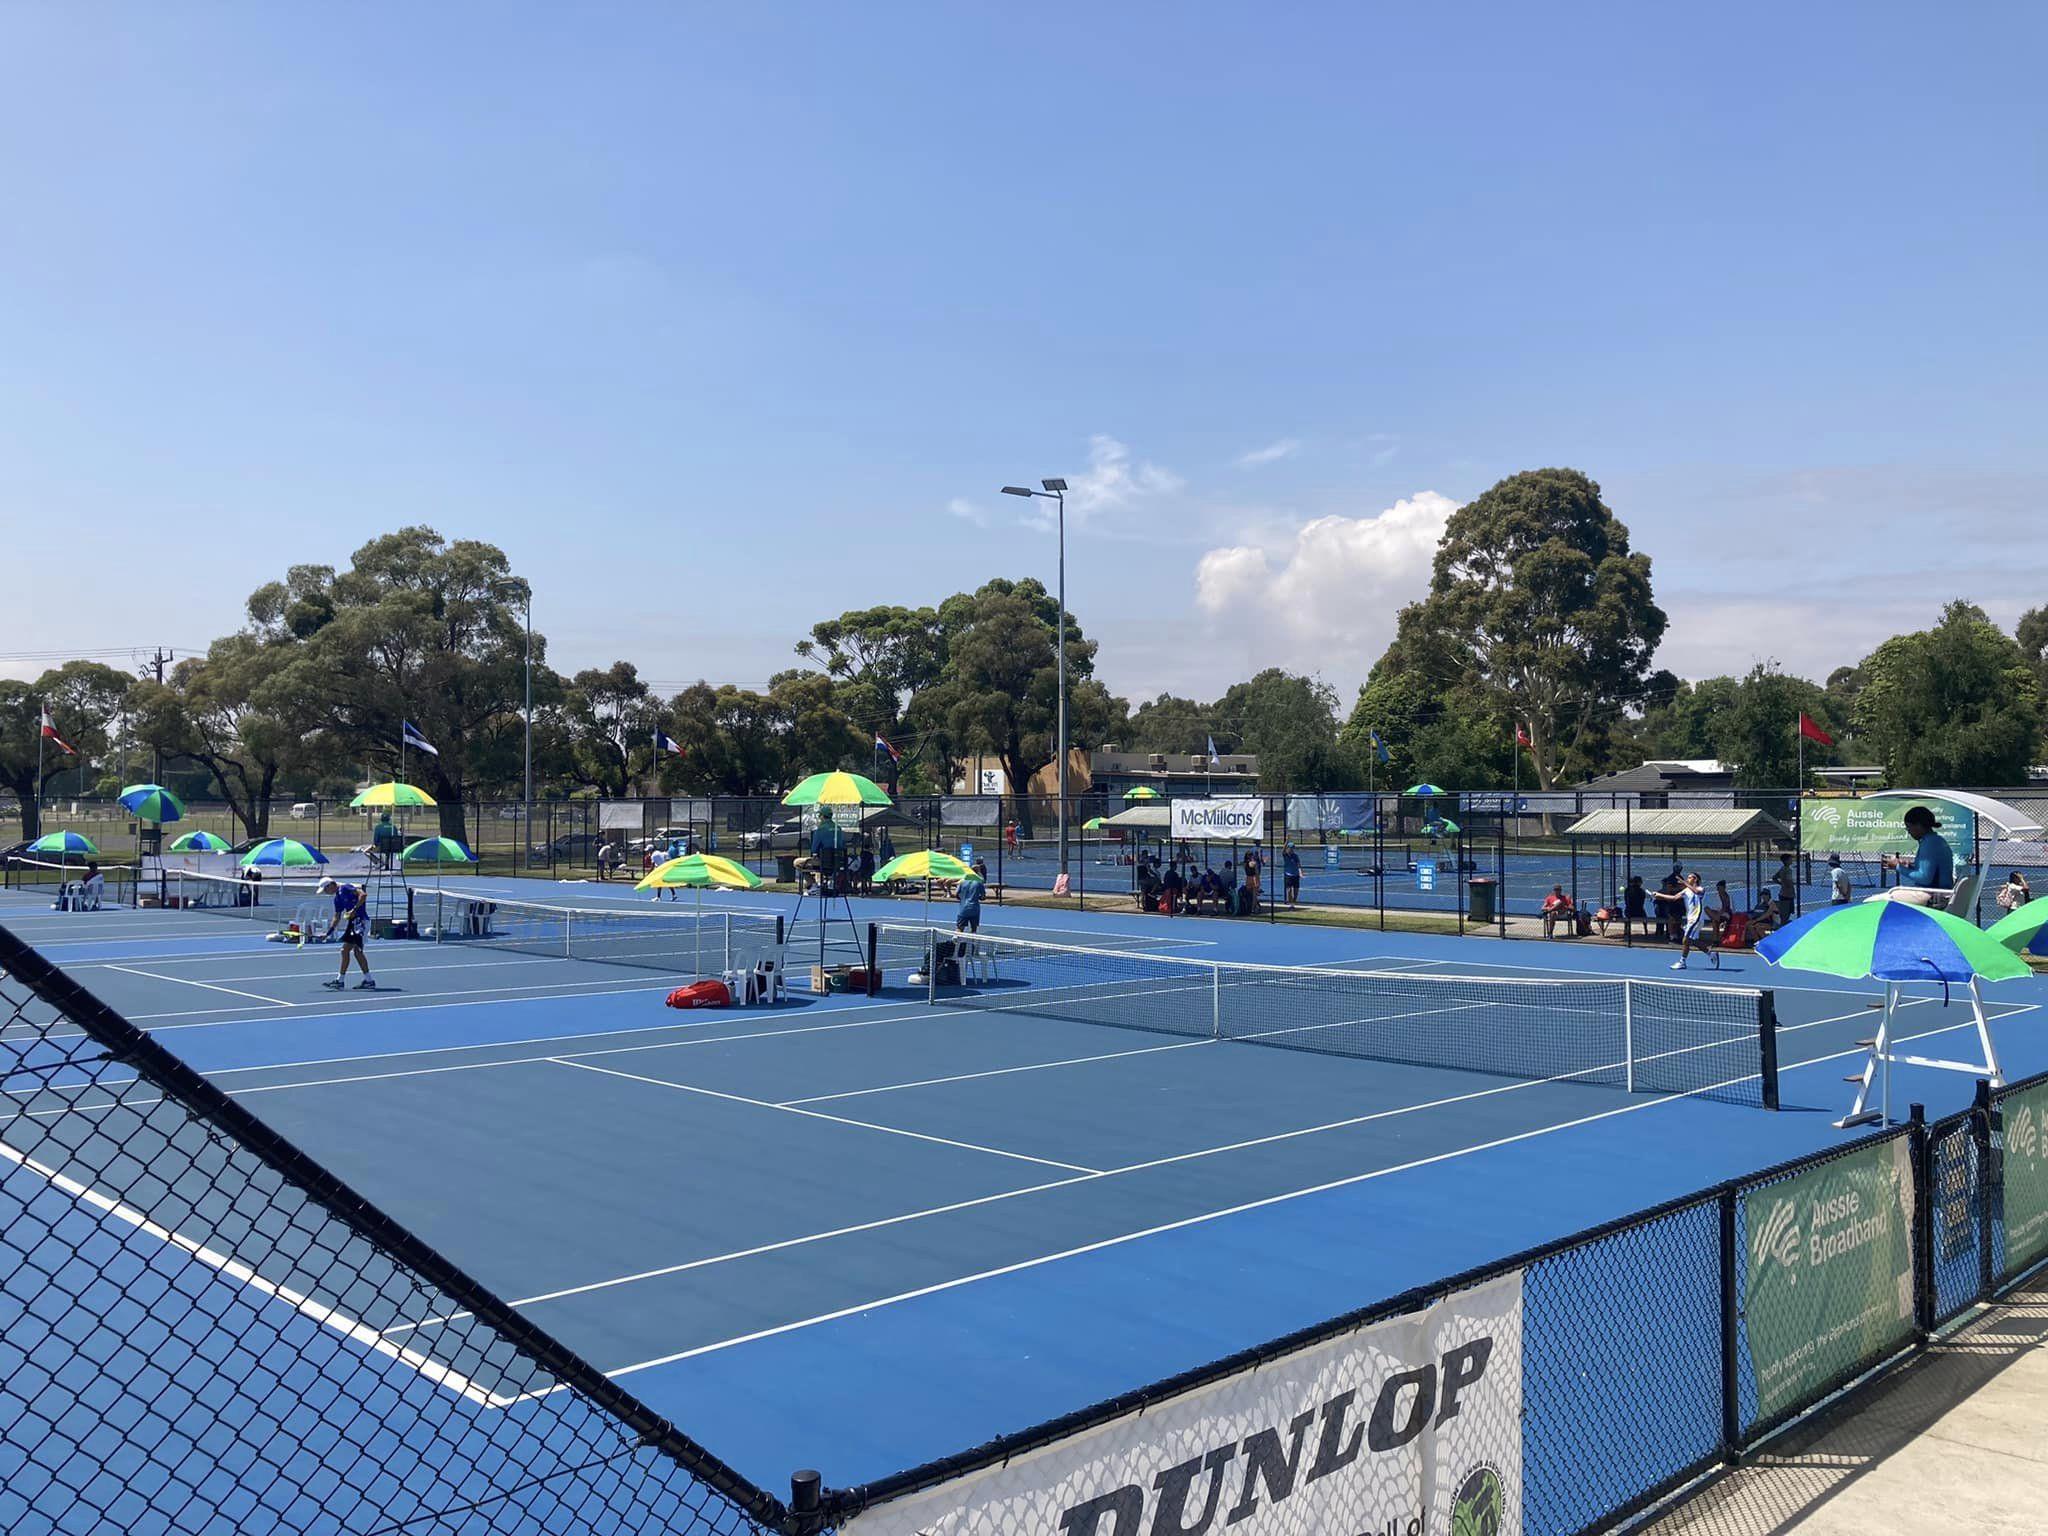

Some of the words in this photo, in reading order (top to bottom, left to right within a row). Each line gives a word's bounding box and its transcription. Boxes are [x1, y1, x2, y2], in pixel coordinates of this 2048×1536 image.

[1181, 808, 1253, 827] McMillans
[1847, 809, 1884, 818] Aussie
[1811, 1187, 1860, 1232] Aussie
[1810, 1206, 1888, 1267] Broadband
[1357, 1516, 1398, 1536] ll
